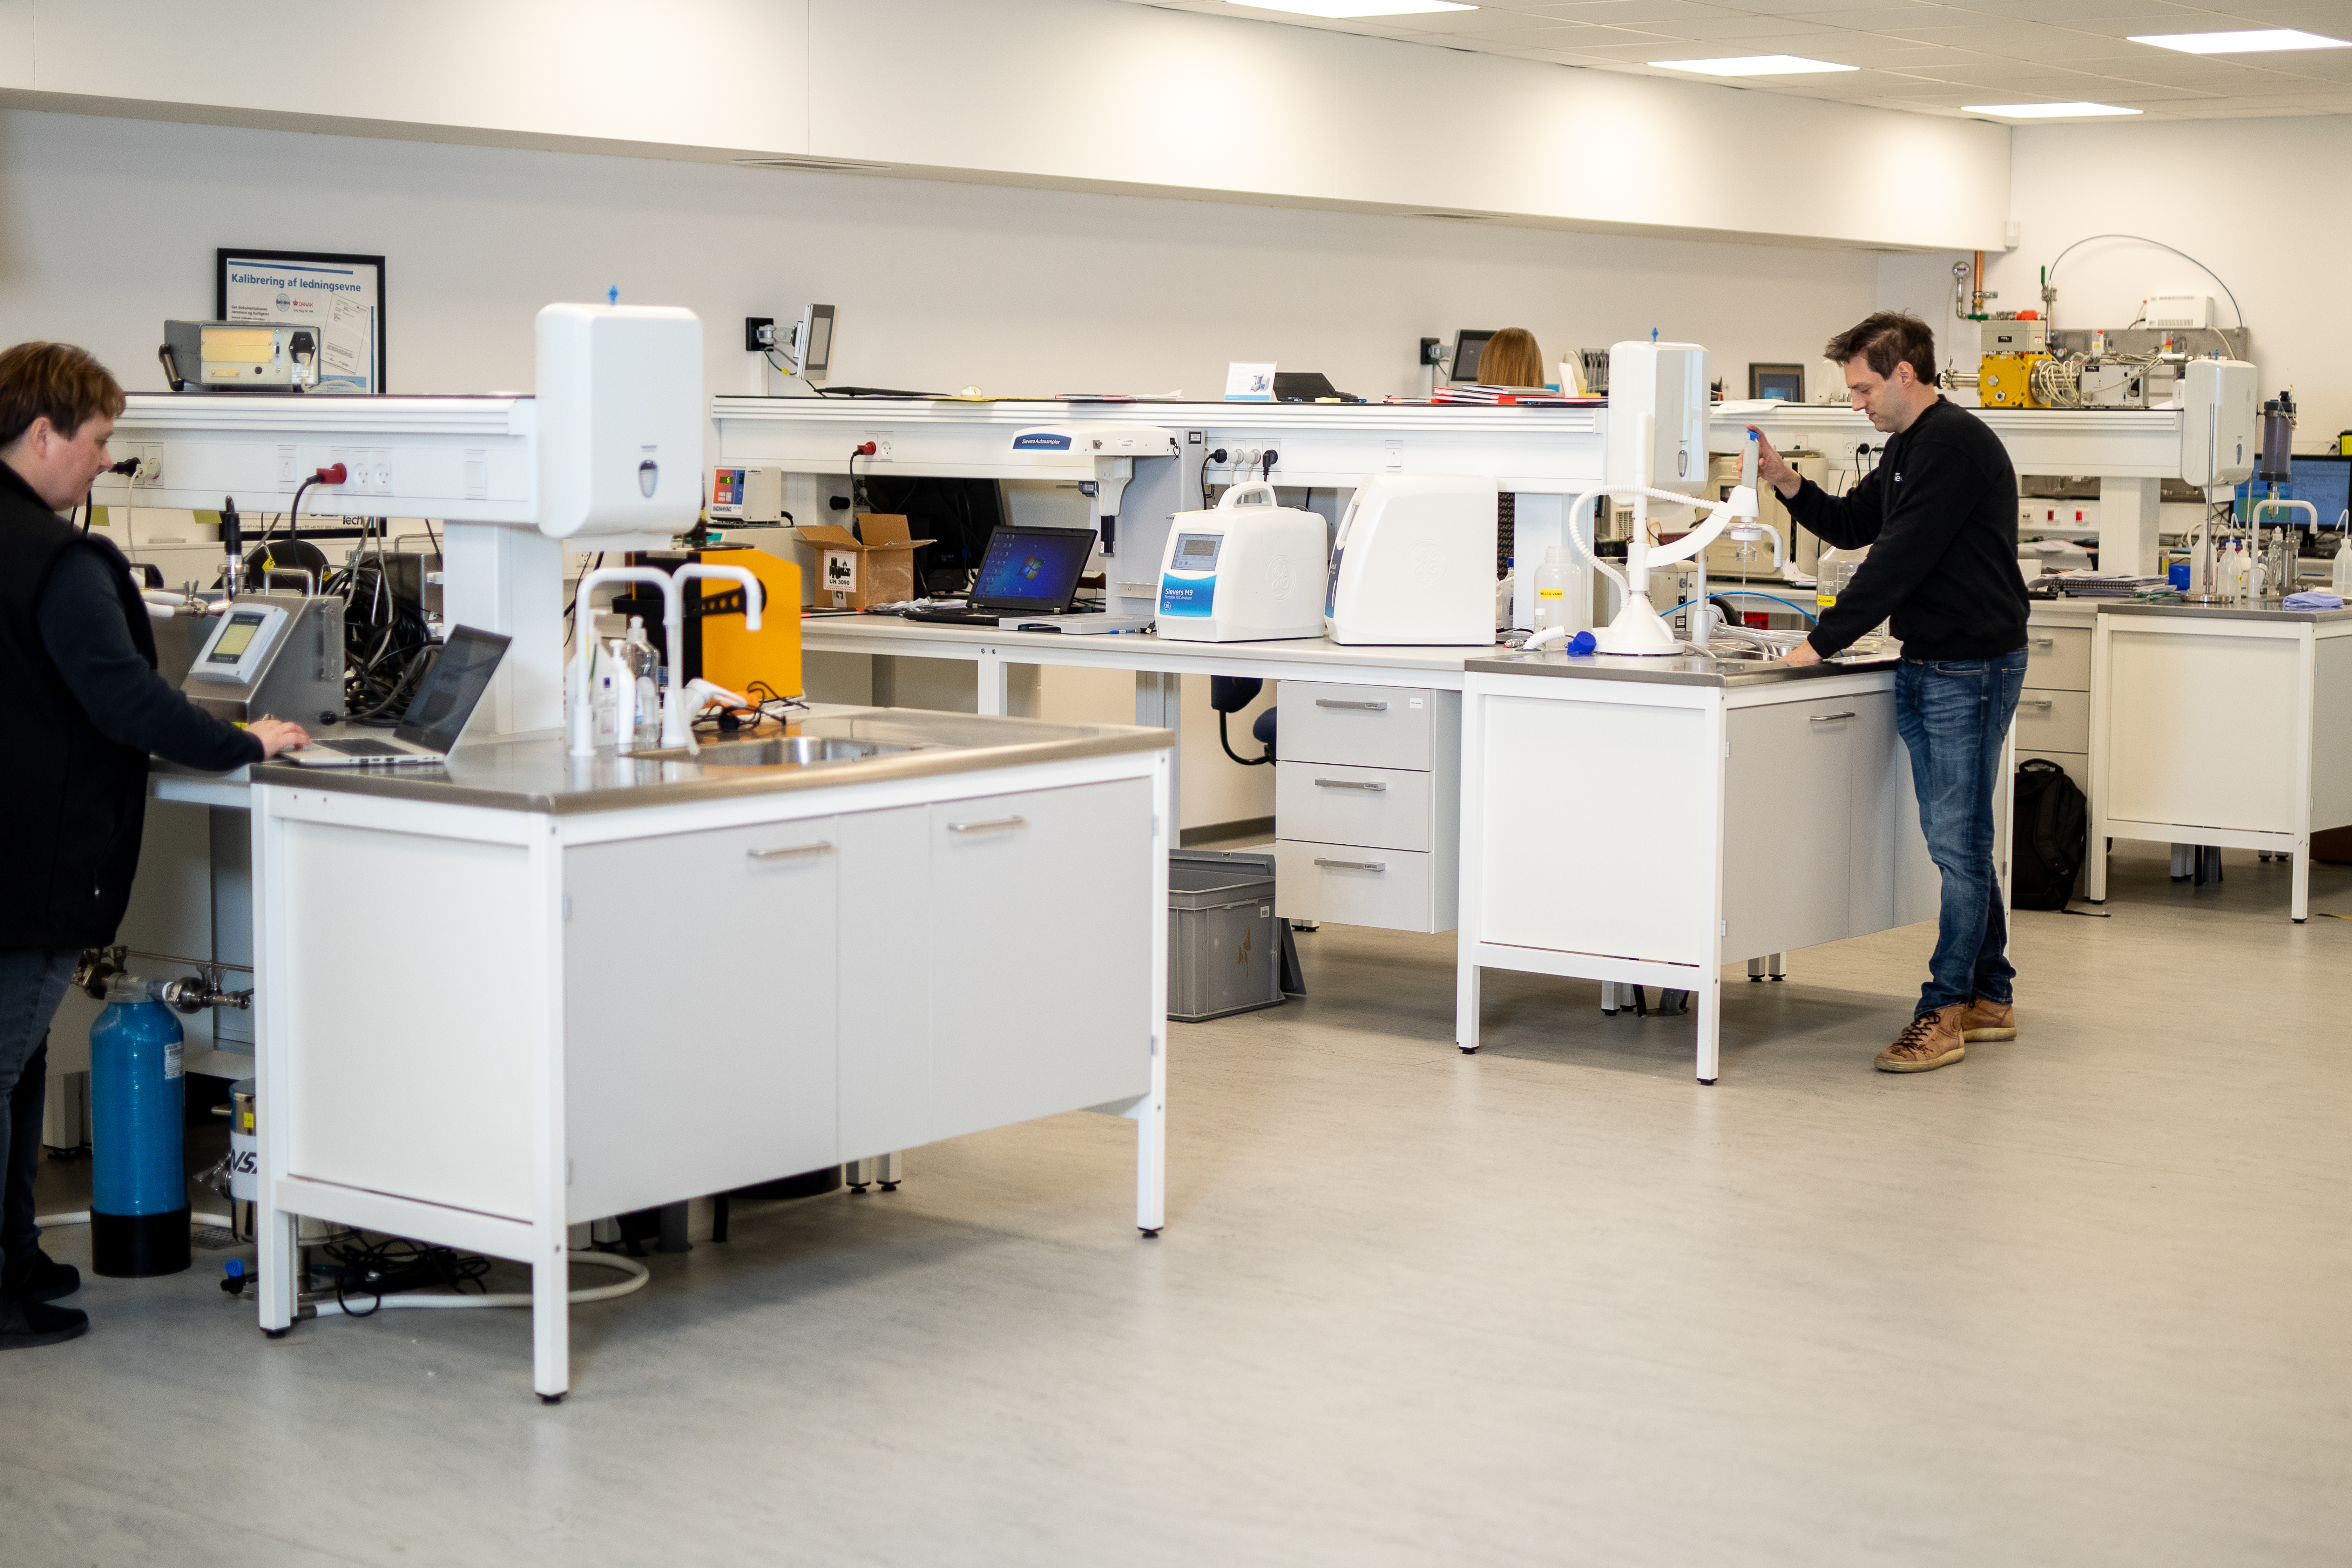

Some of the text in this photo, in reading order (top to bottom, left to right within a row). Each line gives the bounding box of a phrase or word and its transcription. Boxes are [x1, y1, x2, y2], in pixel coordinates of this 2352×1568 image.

[231, 273, 361, 292] Kalibrering af ledningsevne
[231, 1148, 257, 1174] NS
